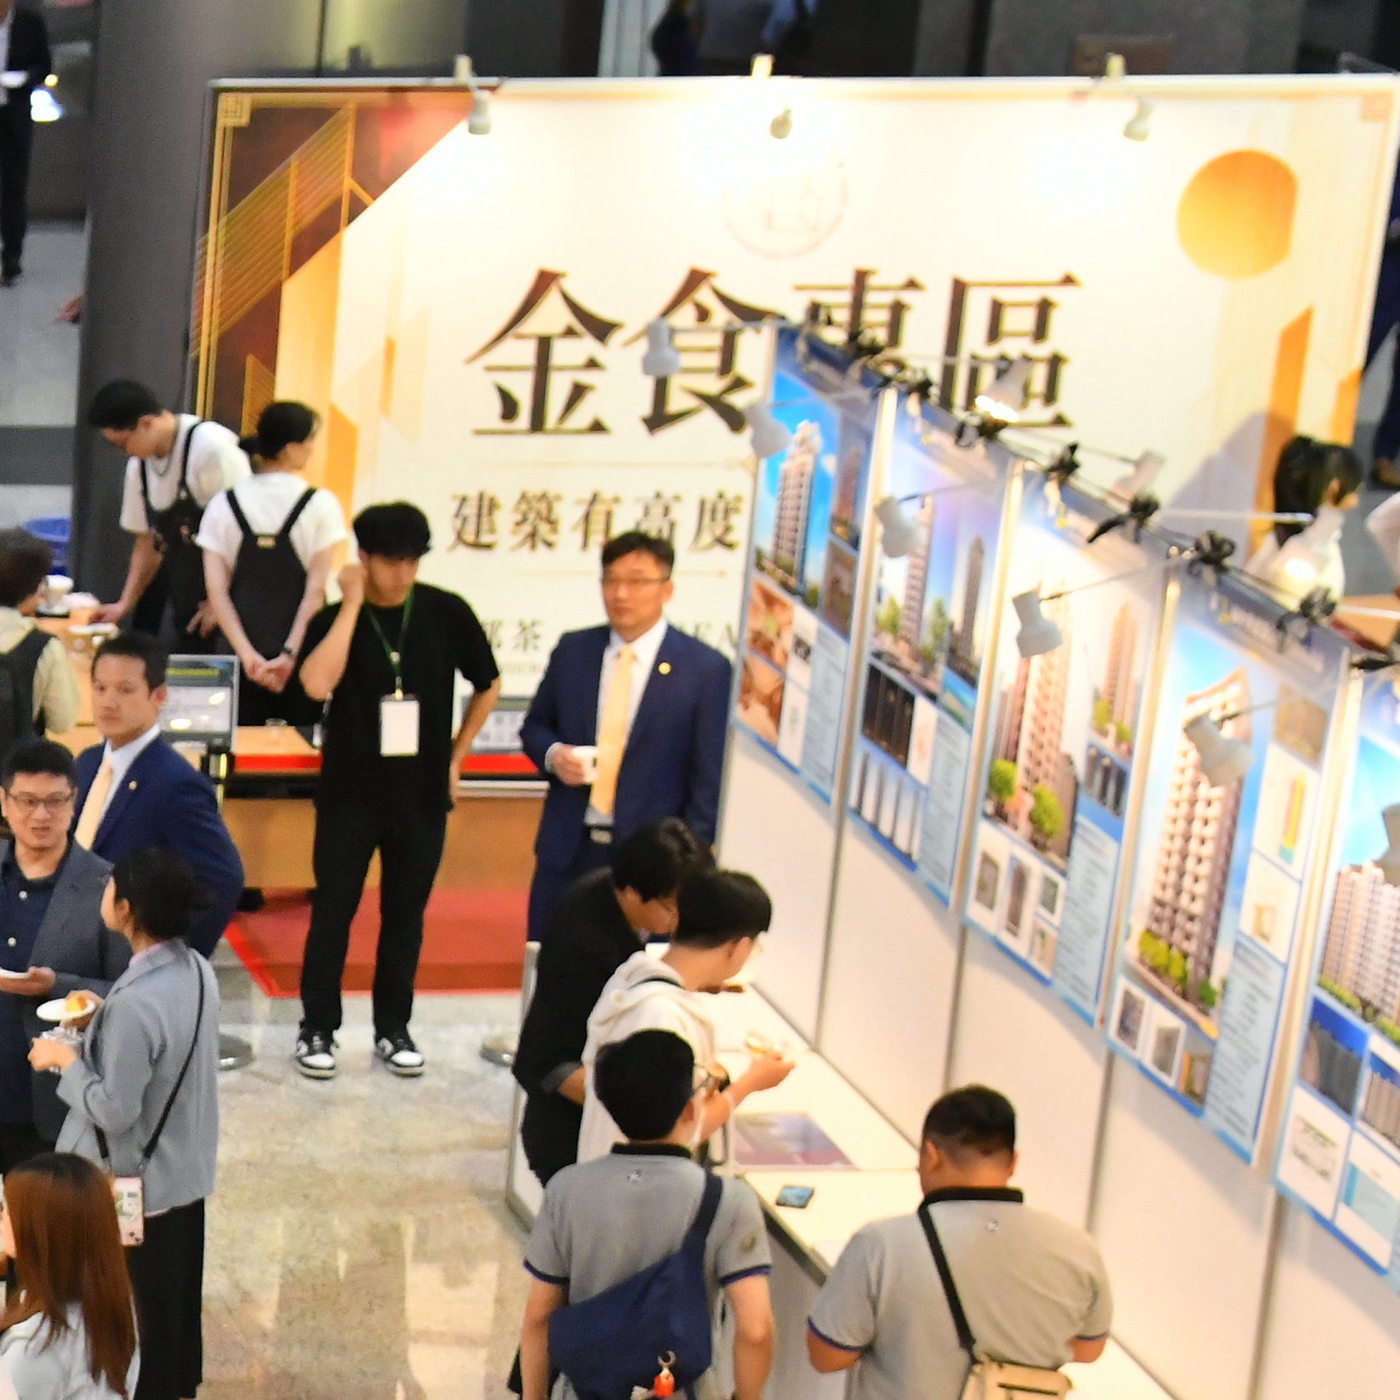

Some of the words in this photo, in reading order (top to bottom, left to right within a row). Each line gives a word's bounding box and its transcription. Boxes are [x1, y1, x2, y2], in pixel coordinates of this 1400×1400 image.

[447, 489, 745, 552] 建築有高度
